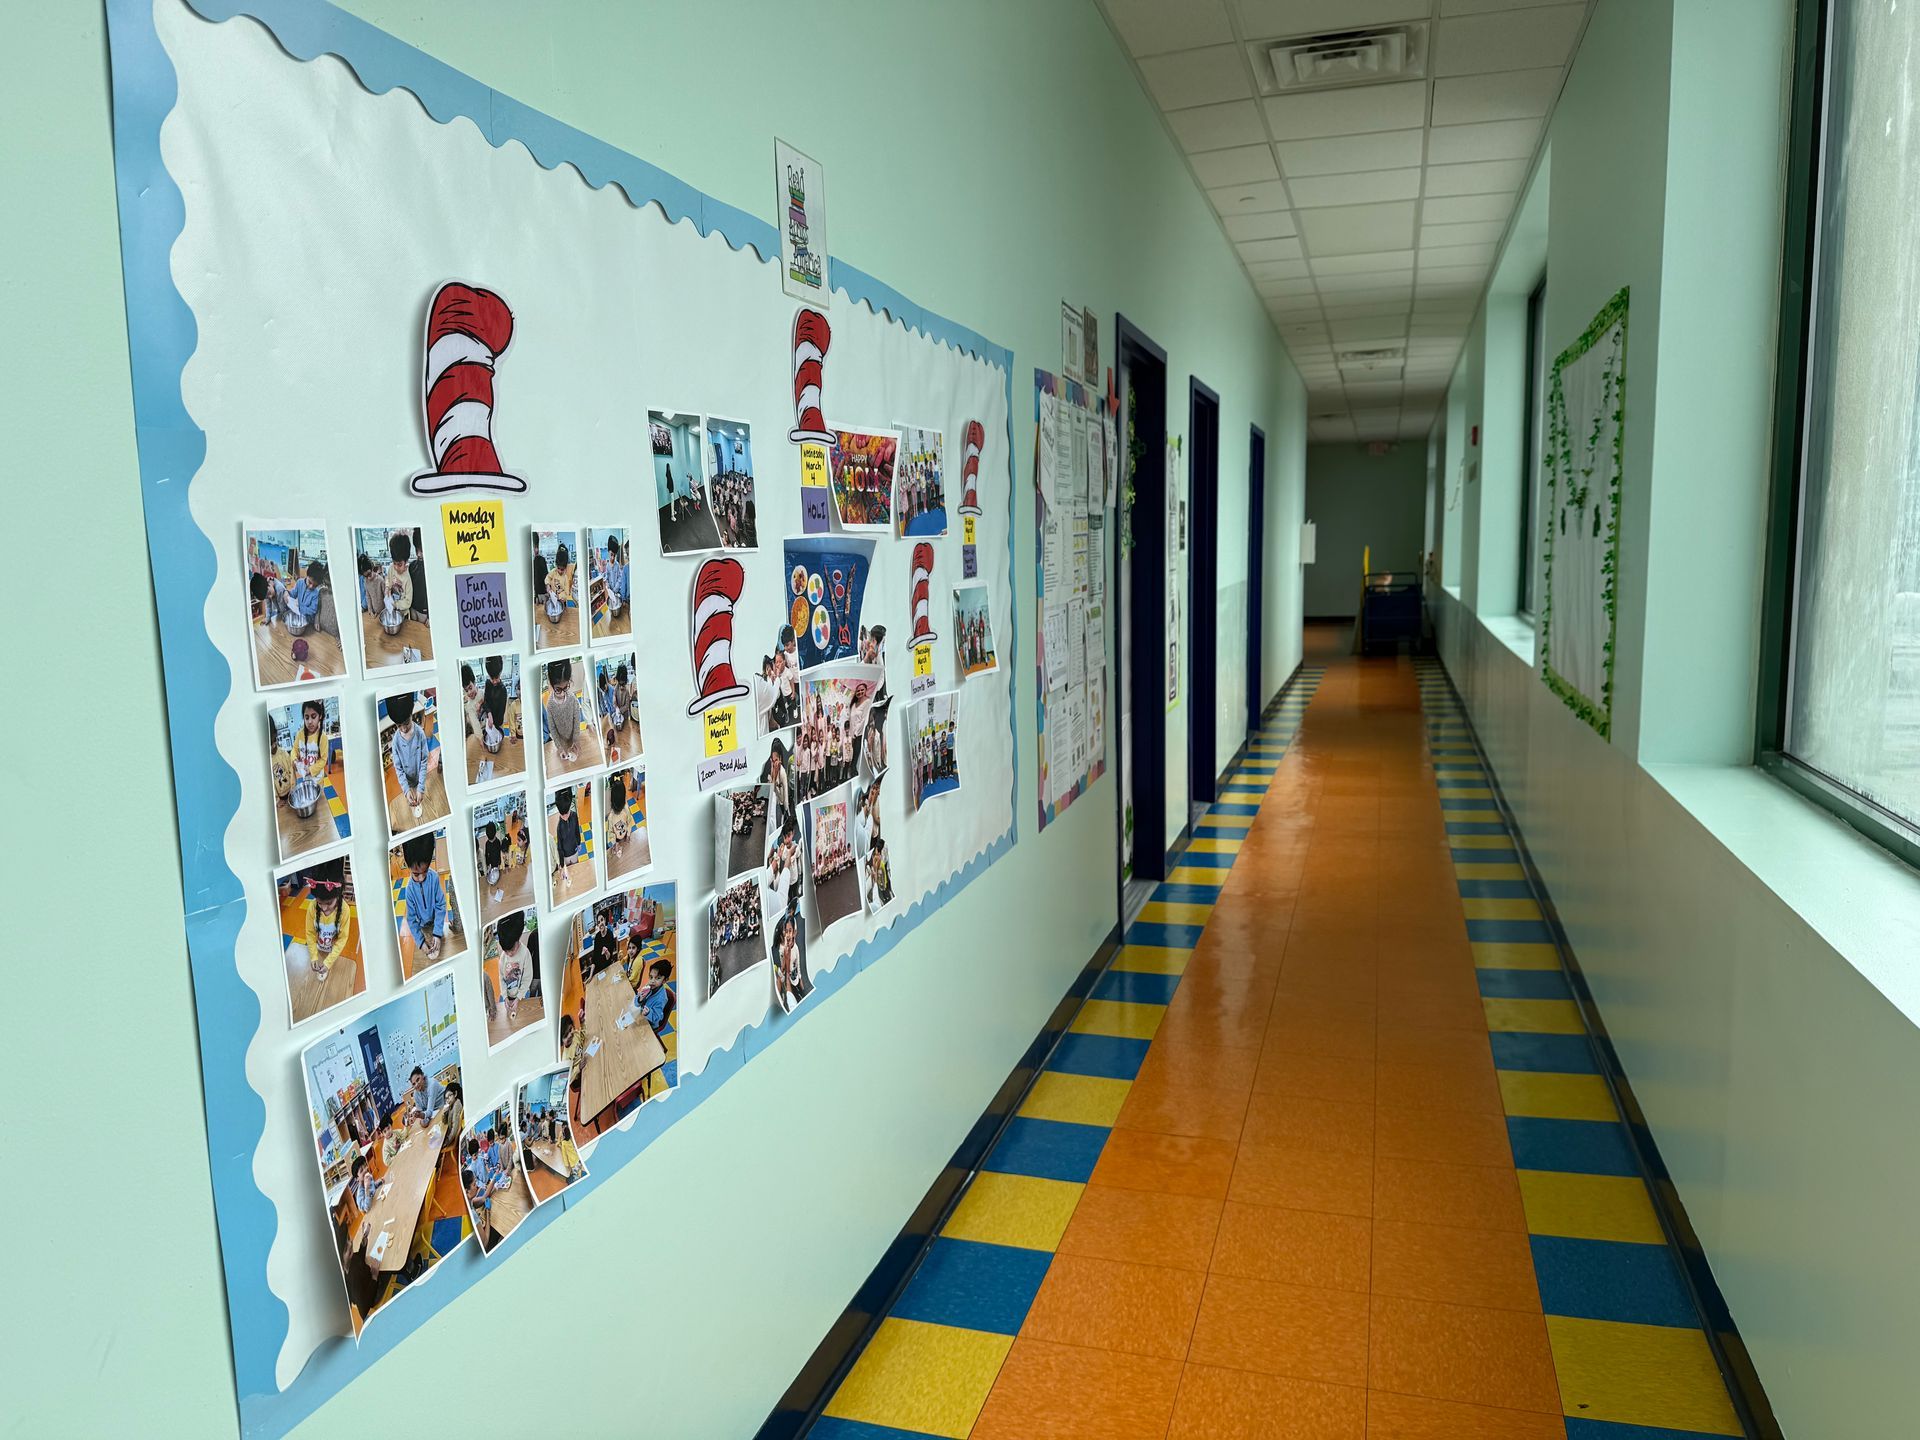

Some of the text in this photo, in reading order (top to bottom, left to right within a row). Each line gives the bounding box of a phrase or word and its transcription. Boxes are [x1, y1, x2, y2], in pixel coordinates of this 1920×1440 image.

[806, 461, 821, 471] March
[851, 453, 868, 464] HAPPY
[811, 472, 816, 486] 4
[843, 465, 879, 493] HOLI
[449, 506, 495, 529] Monday
[807, 501, 826, 520] HOLI
[456, 527, 491, 545] March
[469, 544, 480, 562] 2
[465, 575, 488, 594] Fun
[462, 609, 506, 631] Cupcake
[470, 626, 504, 644] Recipe
[707, 710, 732, 726] Tuesday
[710, 726, 730, 740] March
[718, 740, 724, 752] 3
[700, 756, 748, 782] Zoom Read Aloud
